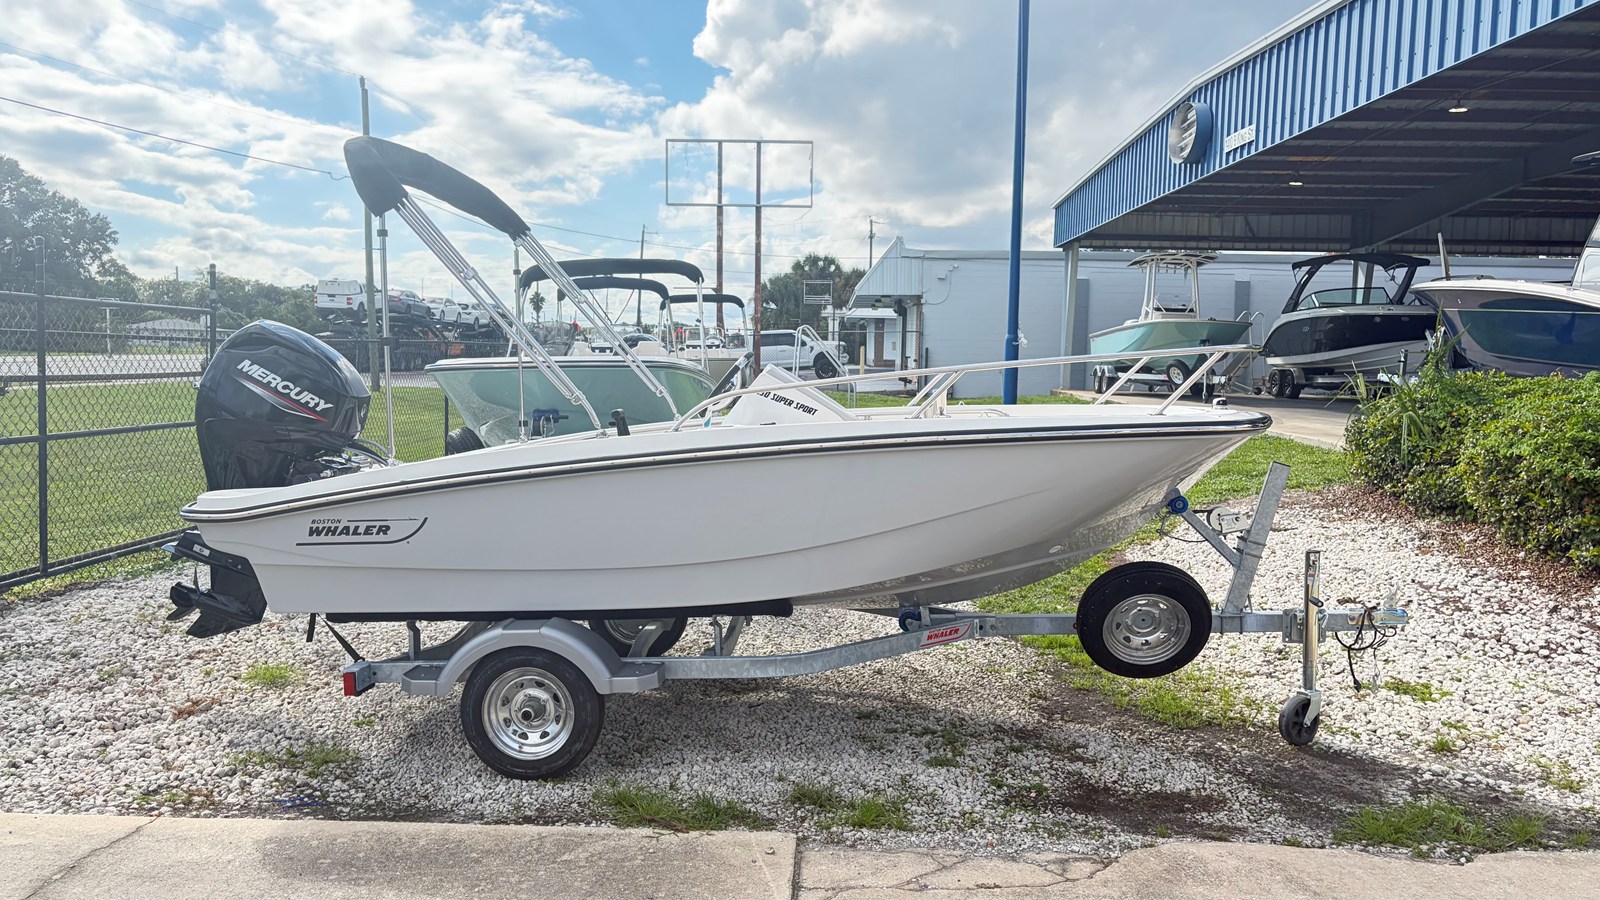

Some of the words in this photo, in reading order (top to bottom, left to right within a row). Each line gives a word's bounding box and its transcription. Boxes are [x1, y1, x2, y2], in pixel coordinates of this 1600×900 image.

[237, 359, 334, 412] MERCURY
[770, 393, 795, 407] SUPER
[793, 402, 818, 416] SPORT
[308, 525, 391, 537] WHALER
[927, 628, 960, 641] WHALER
